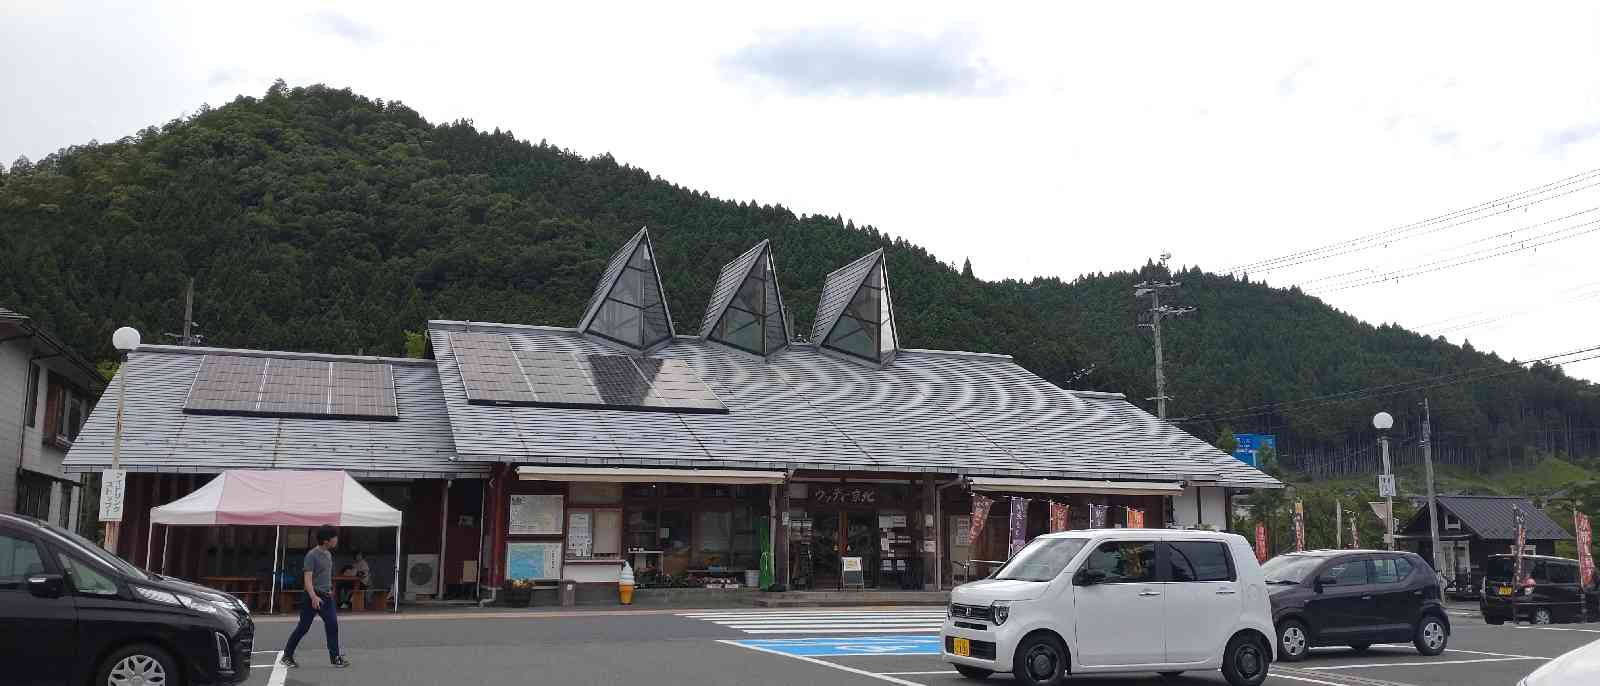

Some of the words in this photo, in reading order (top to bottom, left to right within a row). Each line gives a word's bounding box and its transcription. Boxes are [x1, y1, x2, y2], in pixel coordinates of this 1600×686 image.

[815, 487, 876, 504] ウッディー京北
